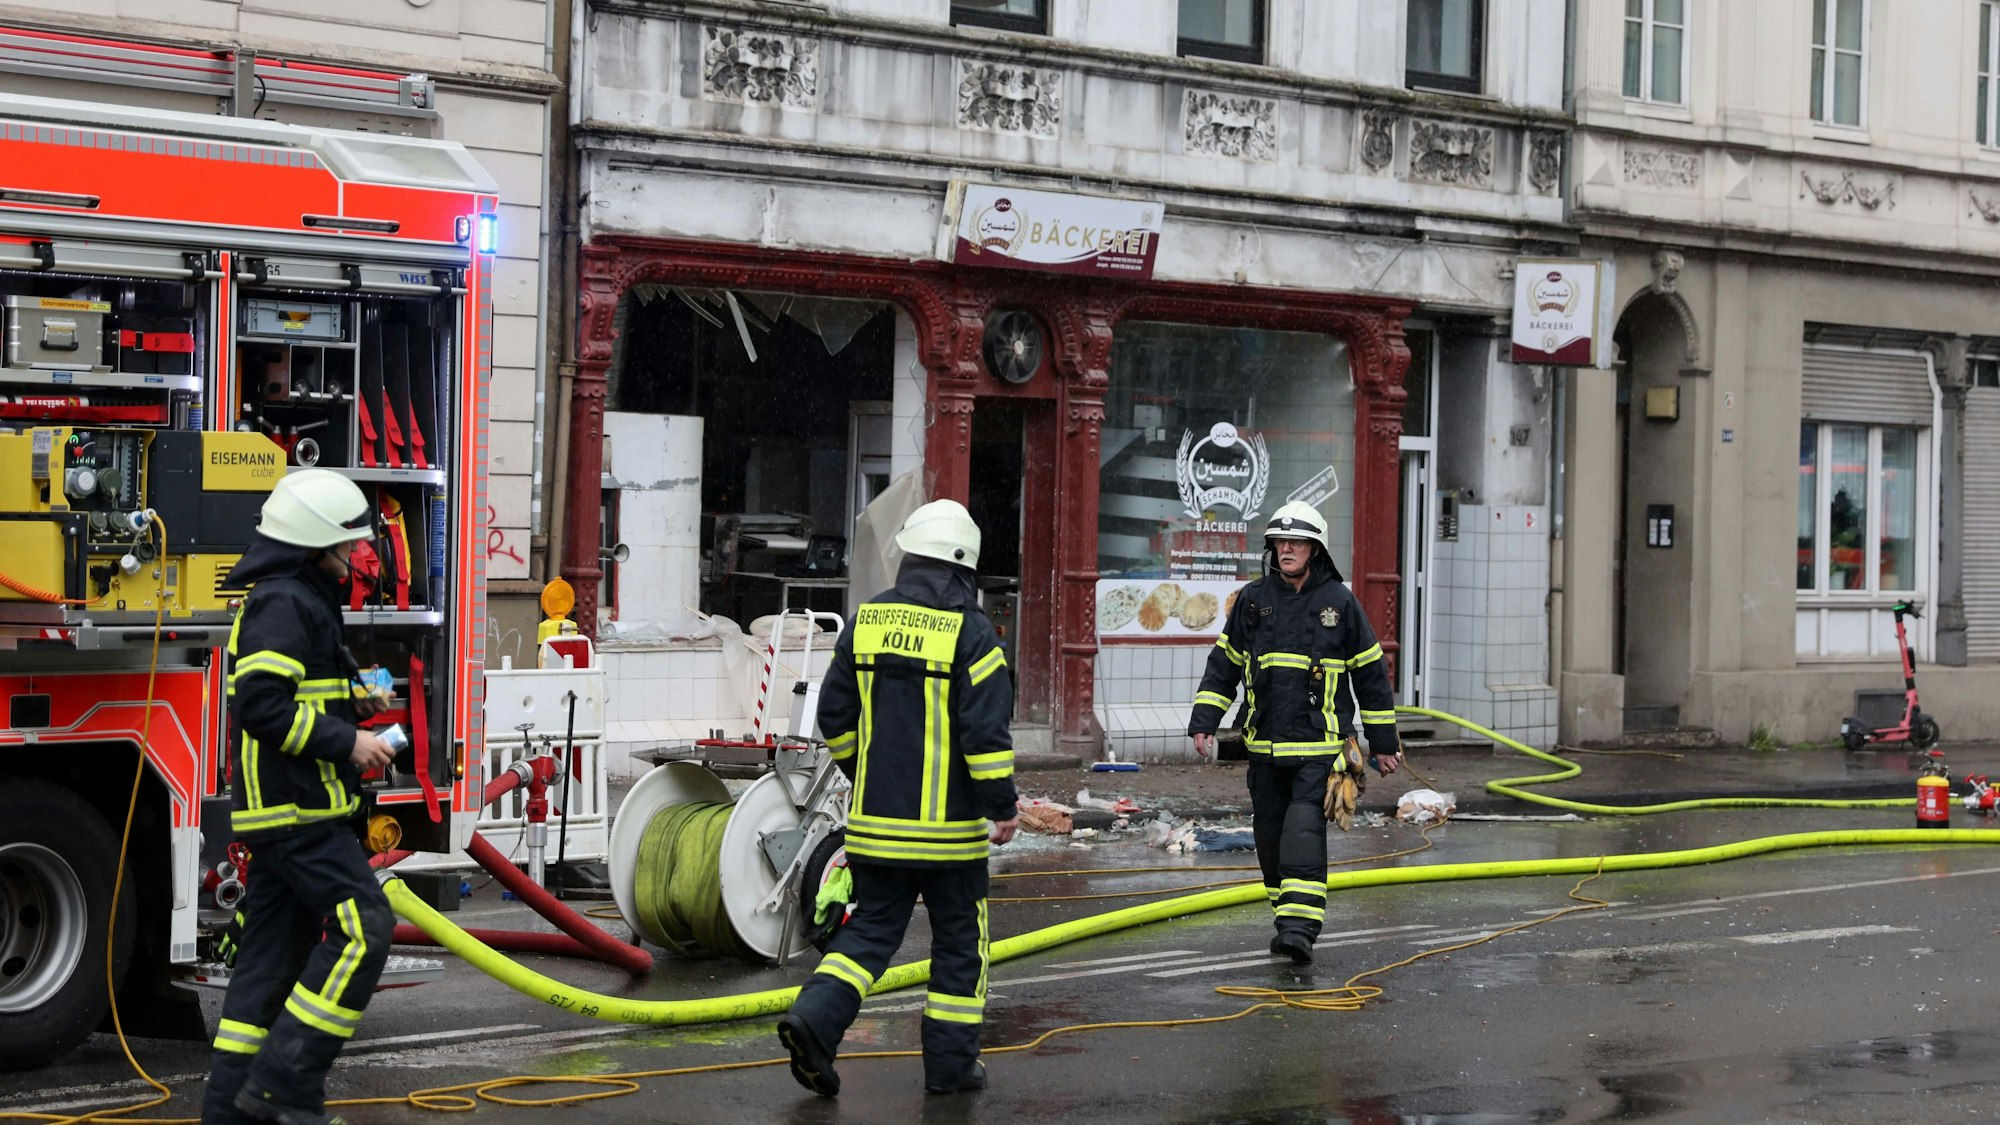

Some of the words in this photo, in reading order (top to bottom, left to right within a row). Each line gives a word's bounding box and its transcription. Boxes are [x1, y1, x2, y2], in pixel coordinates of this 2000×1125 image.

[1030, 219, 1150, 255] BÄCKEREI
[399, 273, 427, 285] WISS
[1529, 320, 1574, 331] BÄCKEREI
[211, 451, 275, 466] EISEMANN
[251, 466, 275, 478] cube
[1195, 457, 1251, 482] شمسين
[1202, 490, 1243, 507] SCHAMSIN
[1196, 518, 1248, 533] BÄCKEREI
[859, 608, 959, 635] BERUFSFEUERWEHR
[881, 627, 925, 653] KÖLN
[579, 1003, 600, 1017] 84
